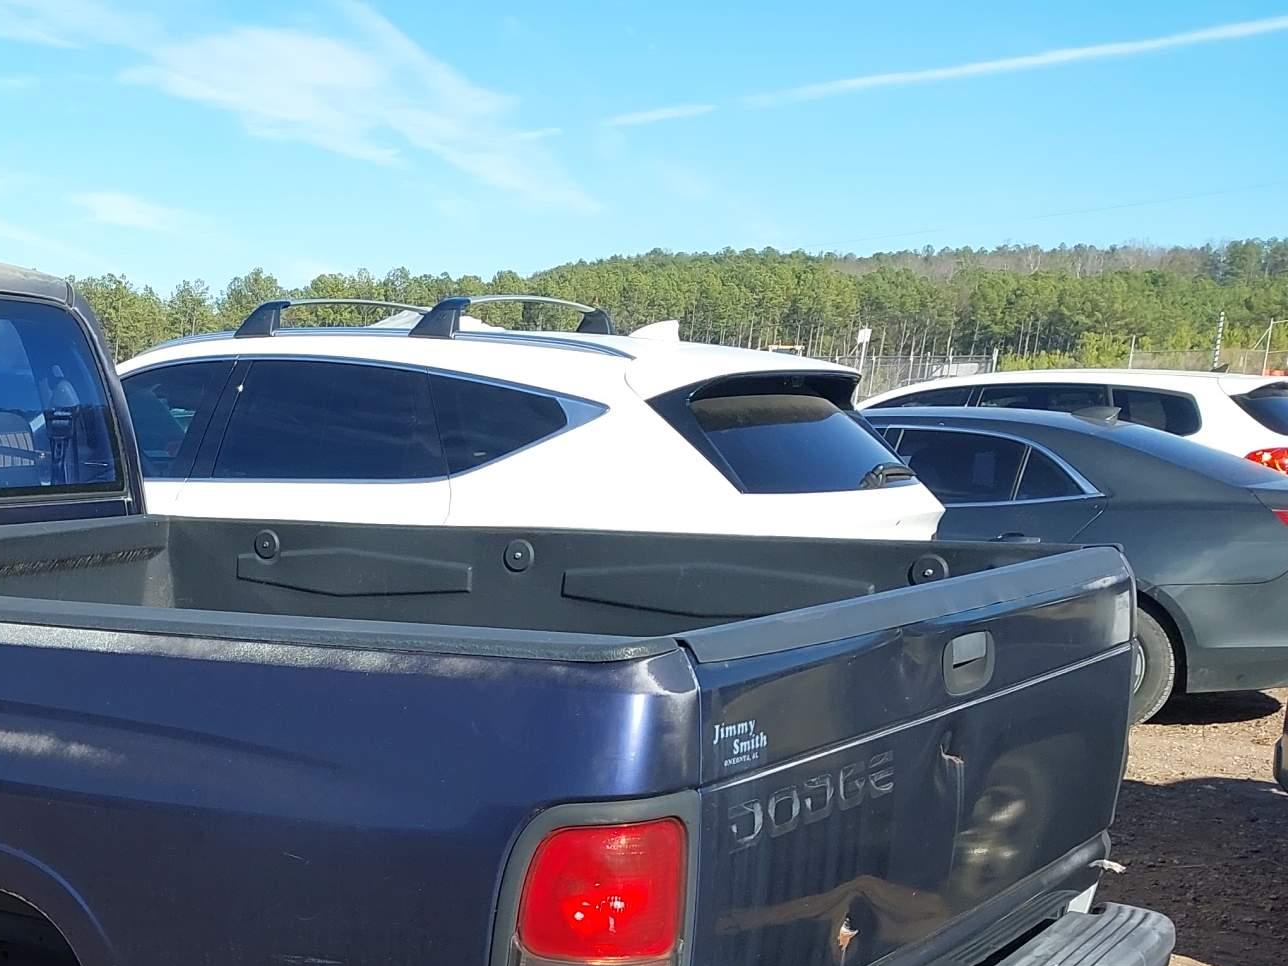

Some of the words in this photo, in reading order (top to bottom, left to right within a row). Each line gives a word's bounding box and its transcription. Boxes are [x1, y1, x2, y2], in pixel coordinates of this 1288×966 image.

[713, 720, 756, 745] Jimmy
[733, 731, 768, 755] Smith
[728, 751, 895, 853] DODGE
